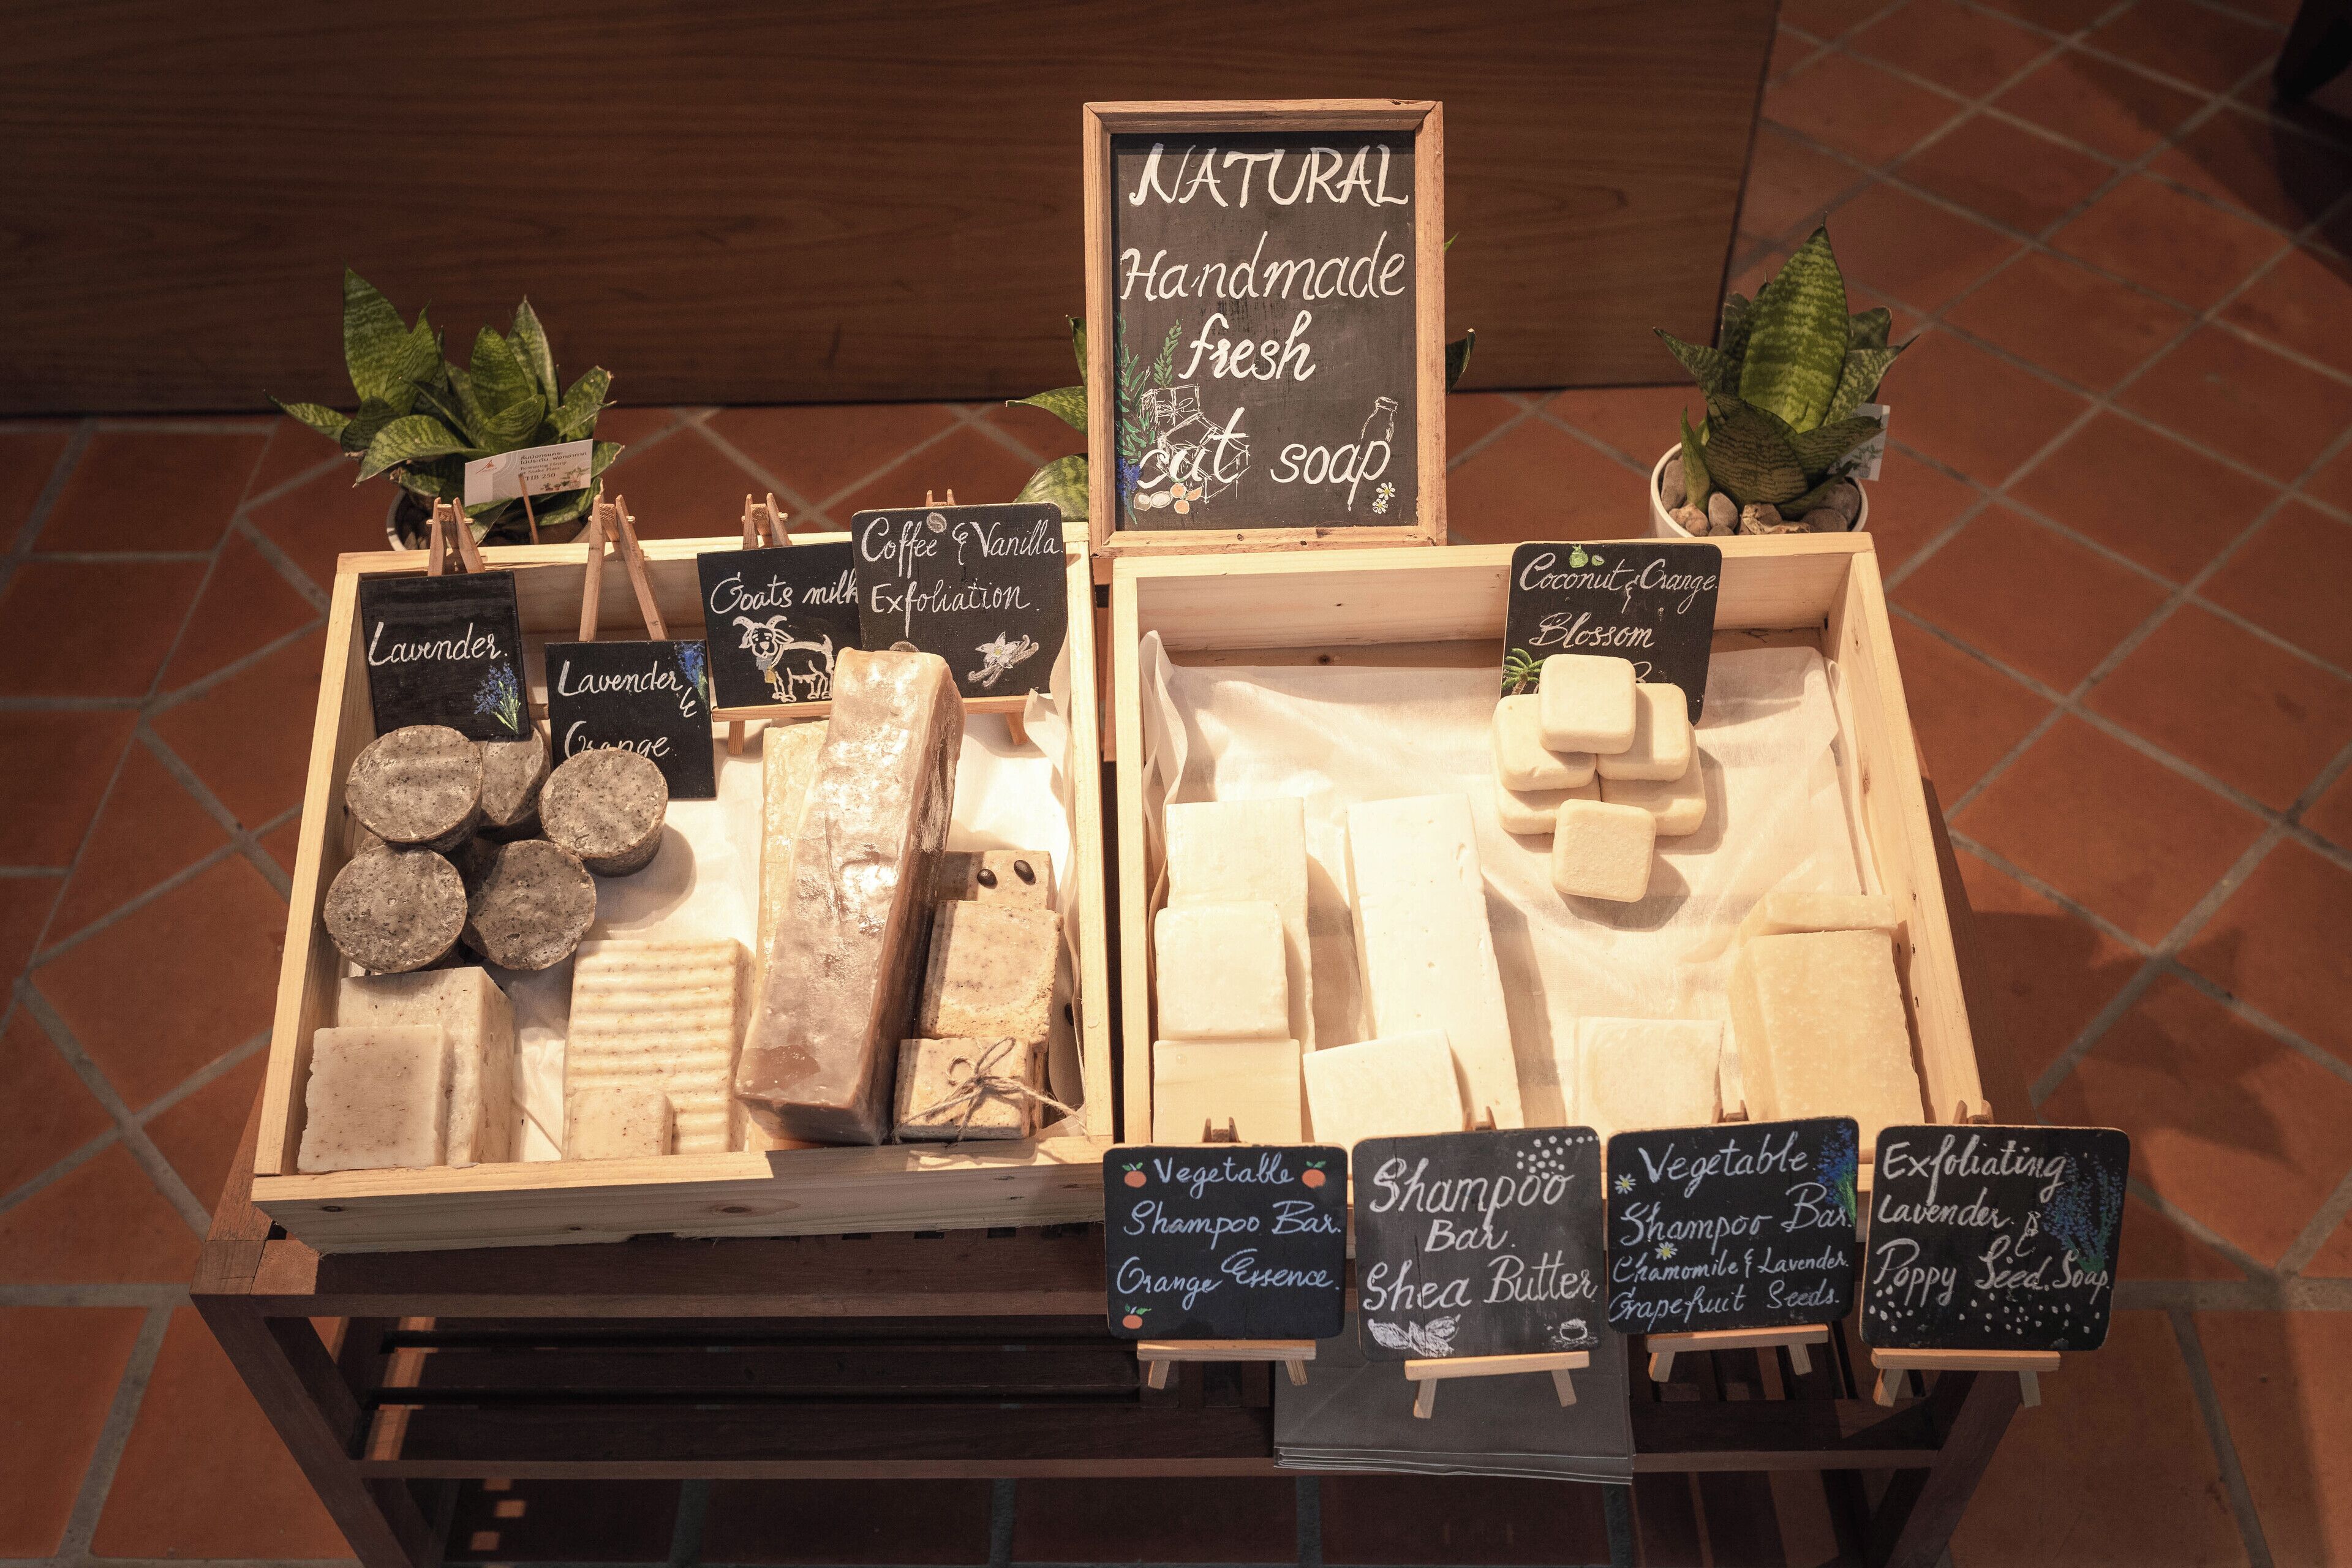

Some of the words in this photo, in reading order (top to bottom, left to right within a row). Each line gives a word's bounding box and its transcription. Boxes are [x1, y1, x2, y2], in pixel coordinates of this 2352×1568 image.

[1129, 143, 1409, 208] NATURAL
[1120, 230, 1406, 301] Handmade
[1178, 309, 1316, 381] fresh
[1137, 407, 1250, 489] cut
[1270, 440, 1392, 511] soap
[861, 517, 938, 578] Coffee
[1520, 552, 1634, 592] Coconut
[710, 572, 792, 614] Goats
[803, 568, 859, 605] milk
[1528, 612, 1655, 649] Blossom
[557, 660, 684, 696] Lavender
[1154, 1152, 1294, 1199] Vegetable
[1370, 1157, 1575, 1227] Shampoo
[1883, 1134, 2067, 1205] Exfoliating
[1124, 1200, 1260, 1250] Shampoo
[1620, 1202, 1773, 1255] Shampoo
[1117, 1256, 1224, 1311] Orange
[1363, 1259, 1472, 1311] Shea
[1613, 1249, 1738, 1283] Chamomile
[1873, 1238, 1957, 1307] Poppy
[1608, 1284, 1747, 1332] Grapefruit
